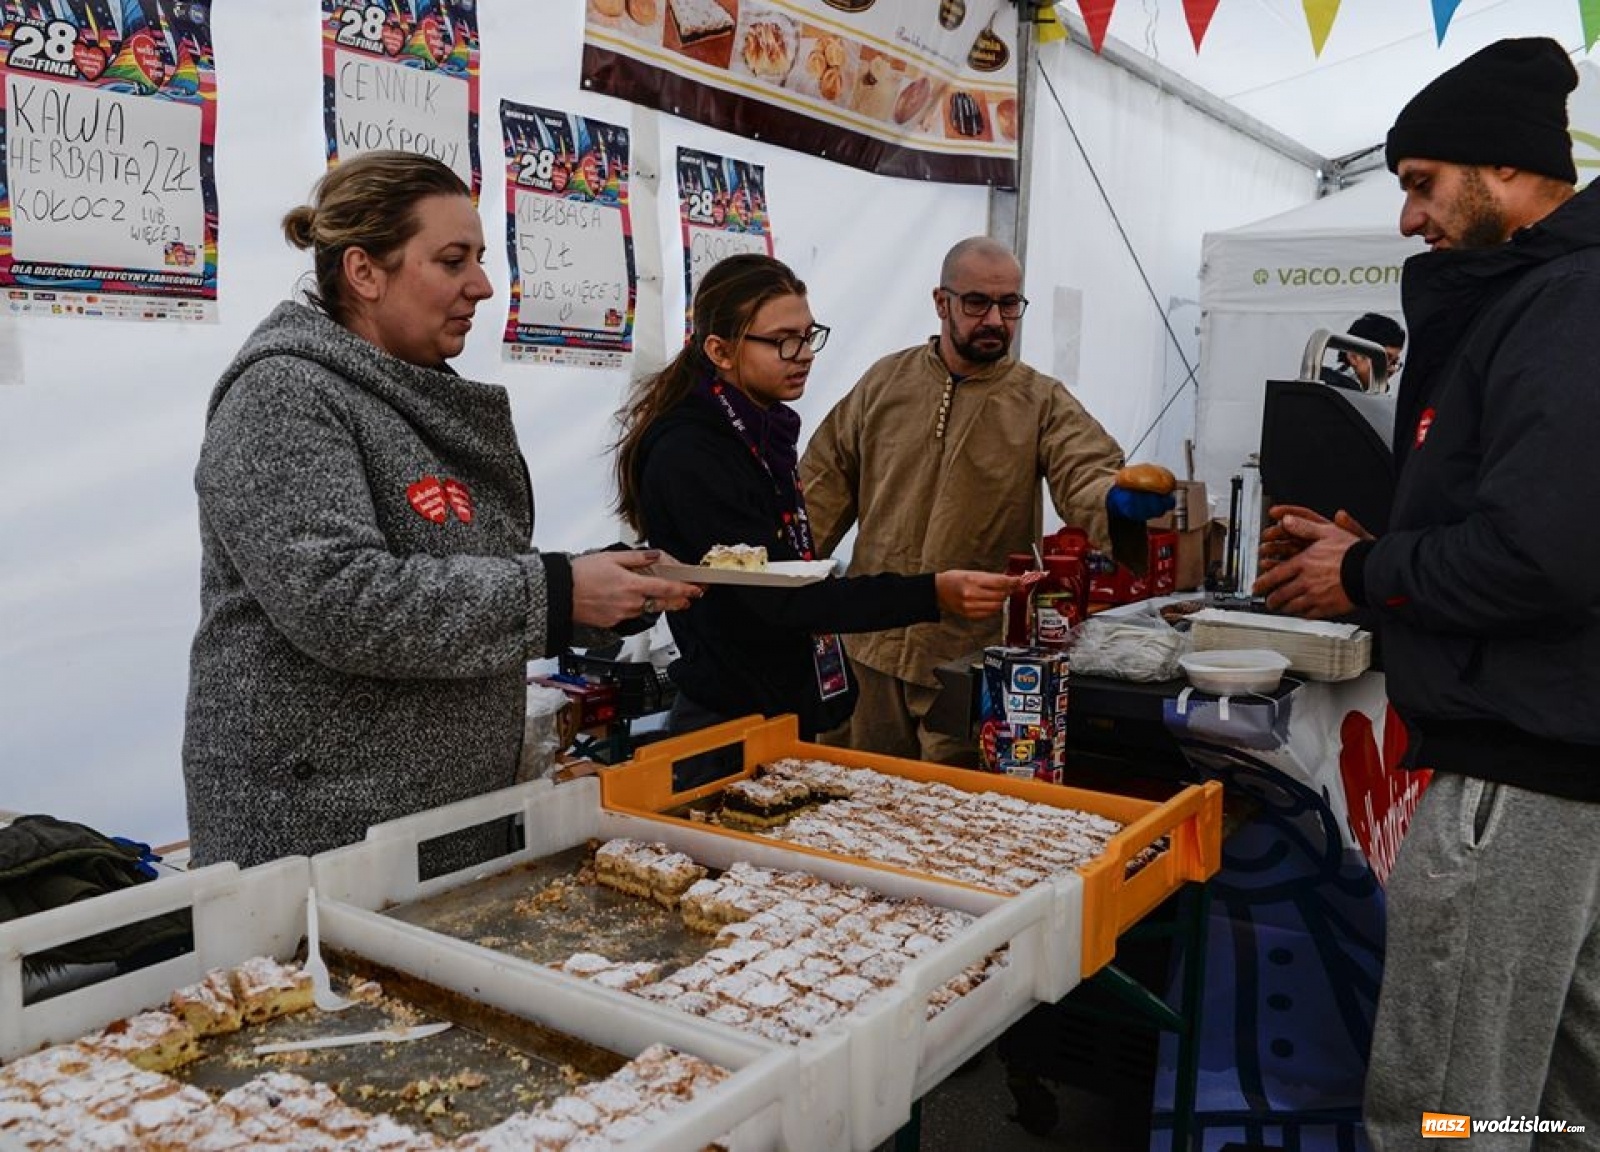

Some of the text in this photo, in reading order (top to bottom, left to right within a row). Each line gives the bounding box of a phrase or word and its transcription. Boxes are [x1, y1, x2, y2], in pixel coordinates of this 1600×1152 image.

[339, 6, 387, 41] 28
[10, 21, 77, 62] 28
[339, 61, 441, 117] CENNIK
[12, 83, 125, 146] KAWA
[9, 136, 141, 187] HERBATA
[519, 149, 555, 182] 28
[141, 206, 166, 225] LUB
[690, 190, 713, 218] 28
[130, 224, 181, 246] WIĘCEJ
[522, 279, 556, 300] LUB
